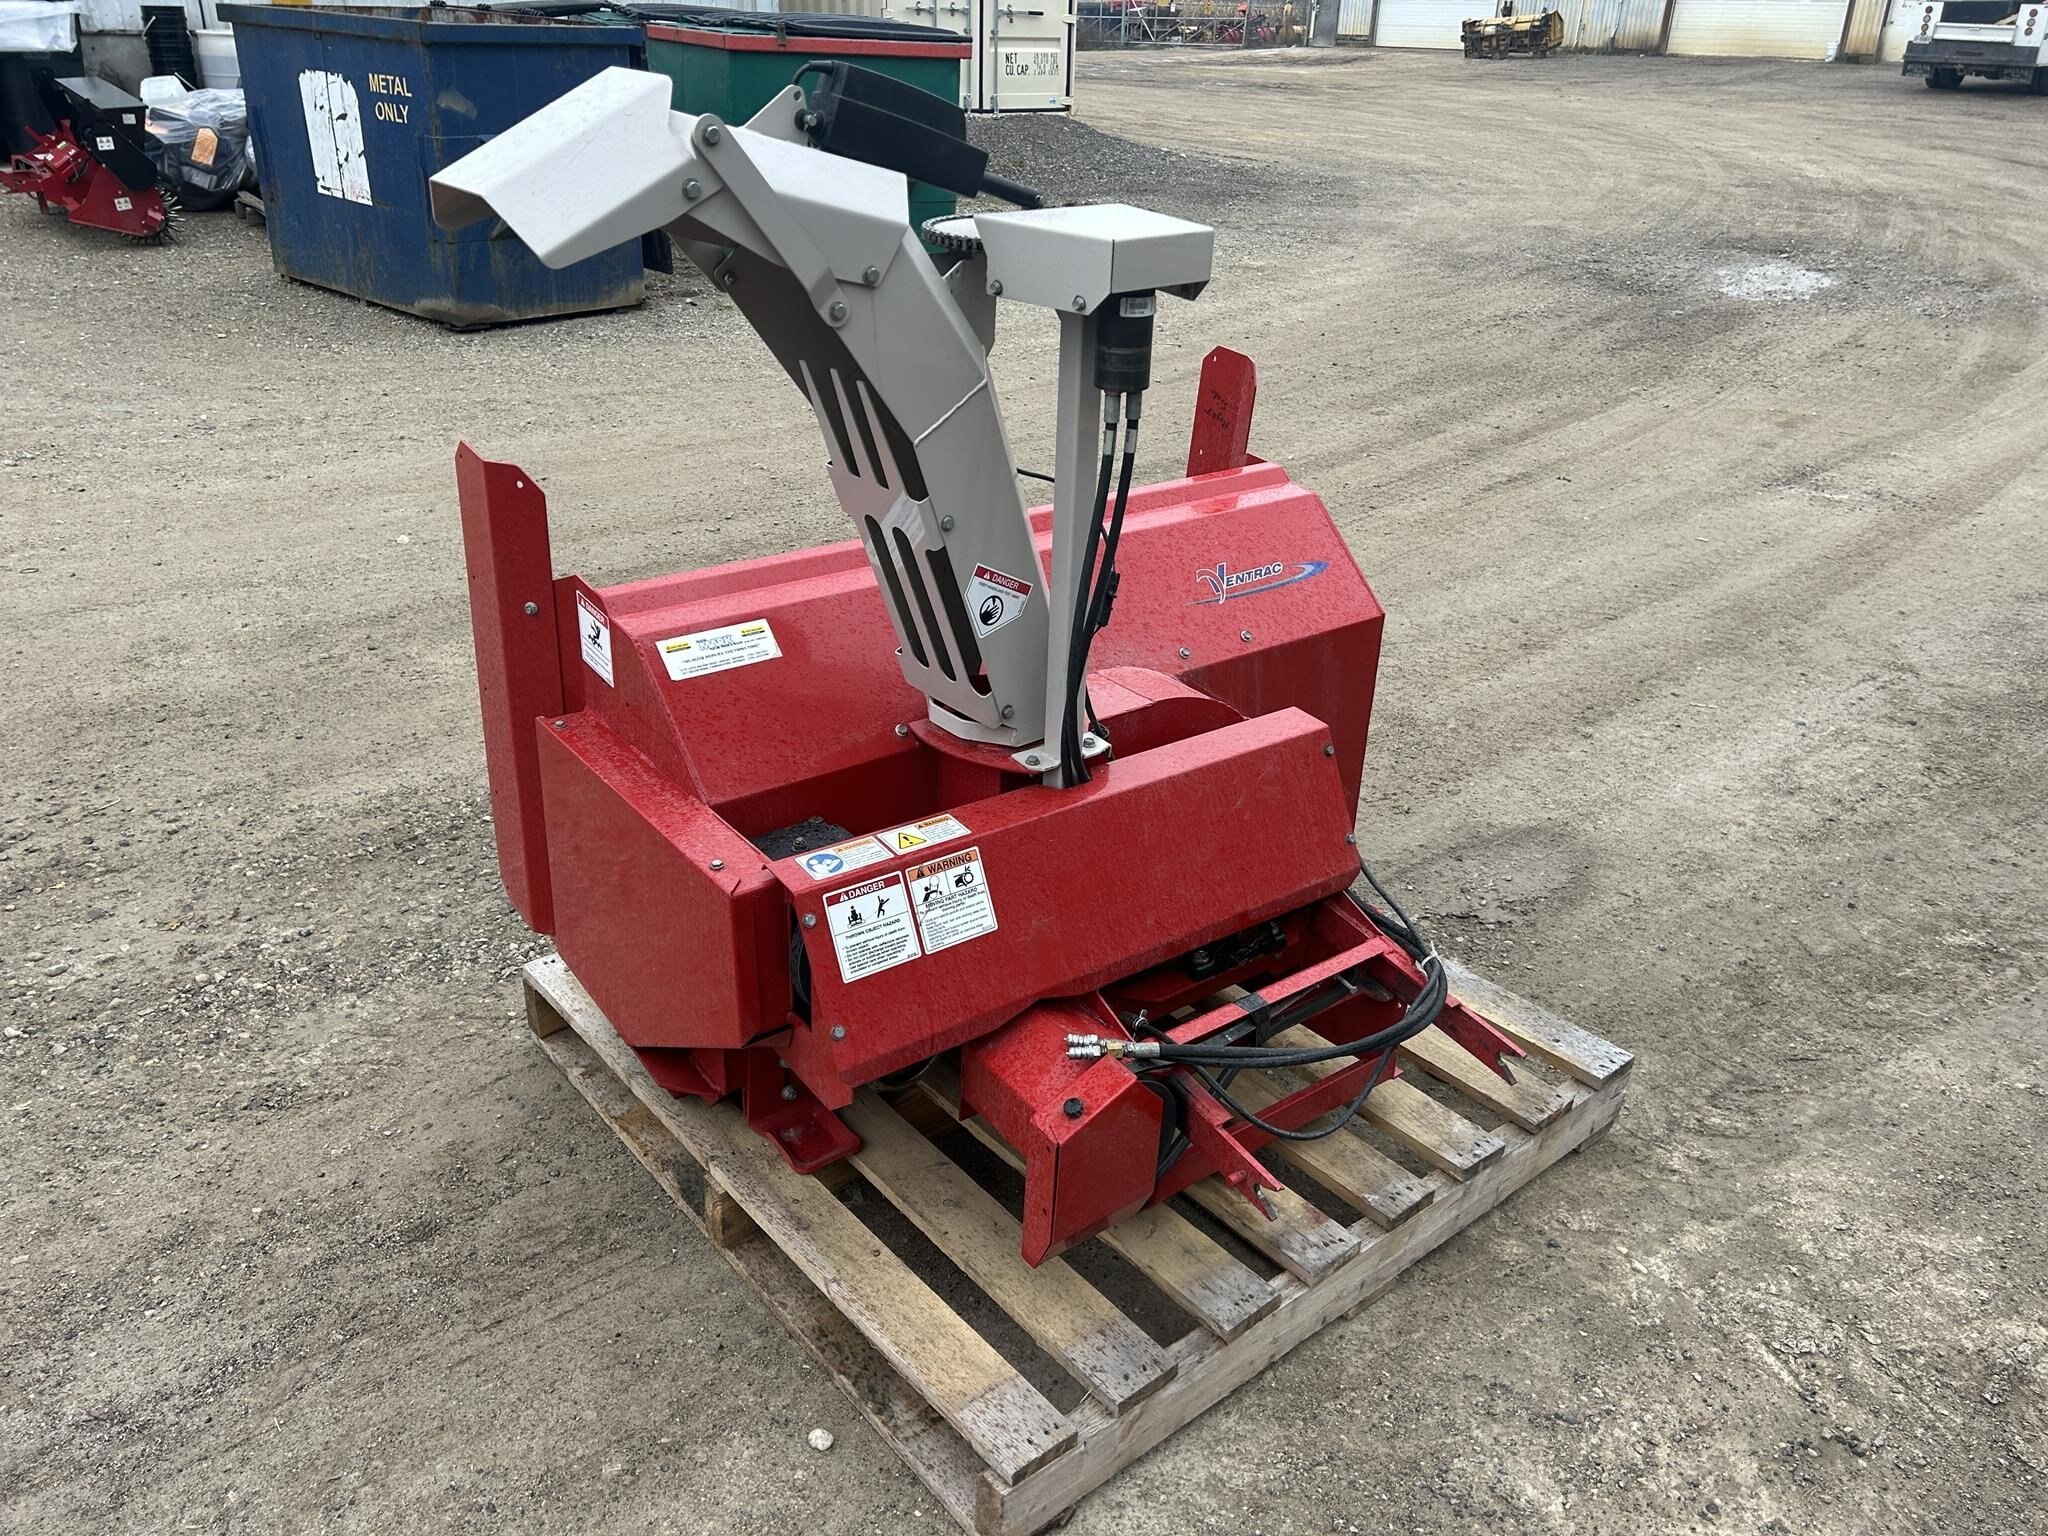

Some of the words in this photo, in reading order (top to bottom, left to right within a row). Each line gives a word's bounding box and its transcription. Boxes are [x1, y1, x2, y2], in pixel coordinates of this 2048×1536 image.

[1005, 53, 1018, 64] NET
[368, 73, 412, 97] METAL
[375, 101, 409, 124] ONLY
[992, 573, 1019, 590] DANGER
[1196, 562, 1283, 604] VENTRAC
[927, 853, 972, 874] WARNING
[848, 880, 885, 899] DANGER
[925, 899, 944, 908] MOVING
[945, 893, 957, 901] PART
[958, 887, 977, 896] HAZARD
[883, 918, 900, 927] HAZARD
